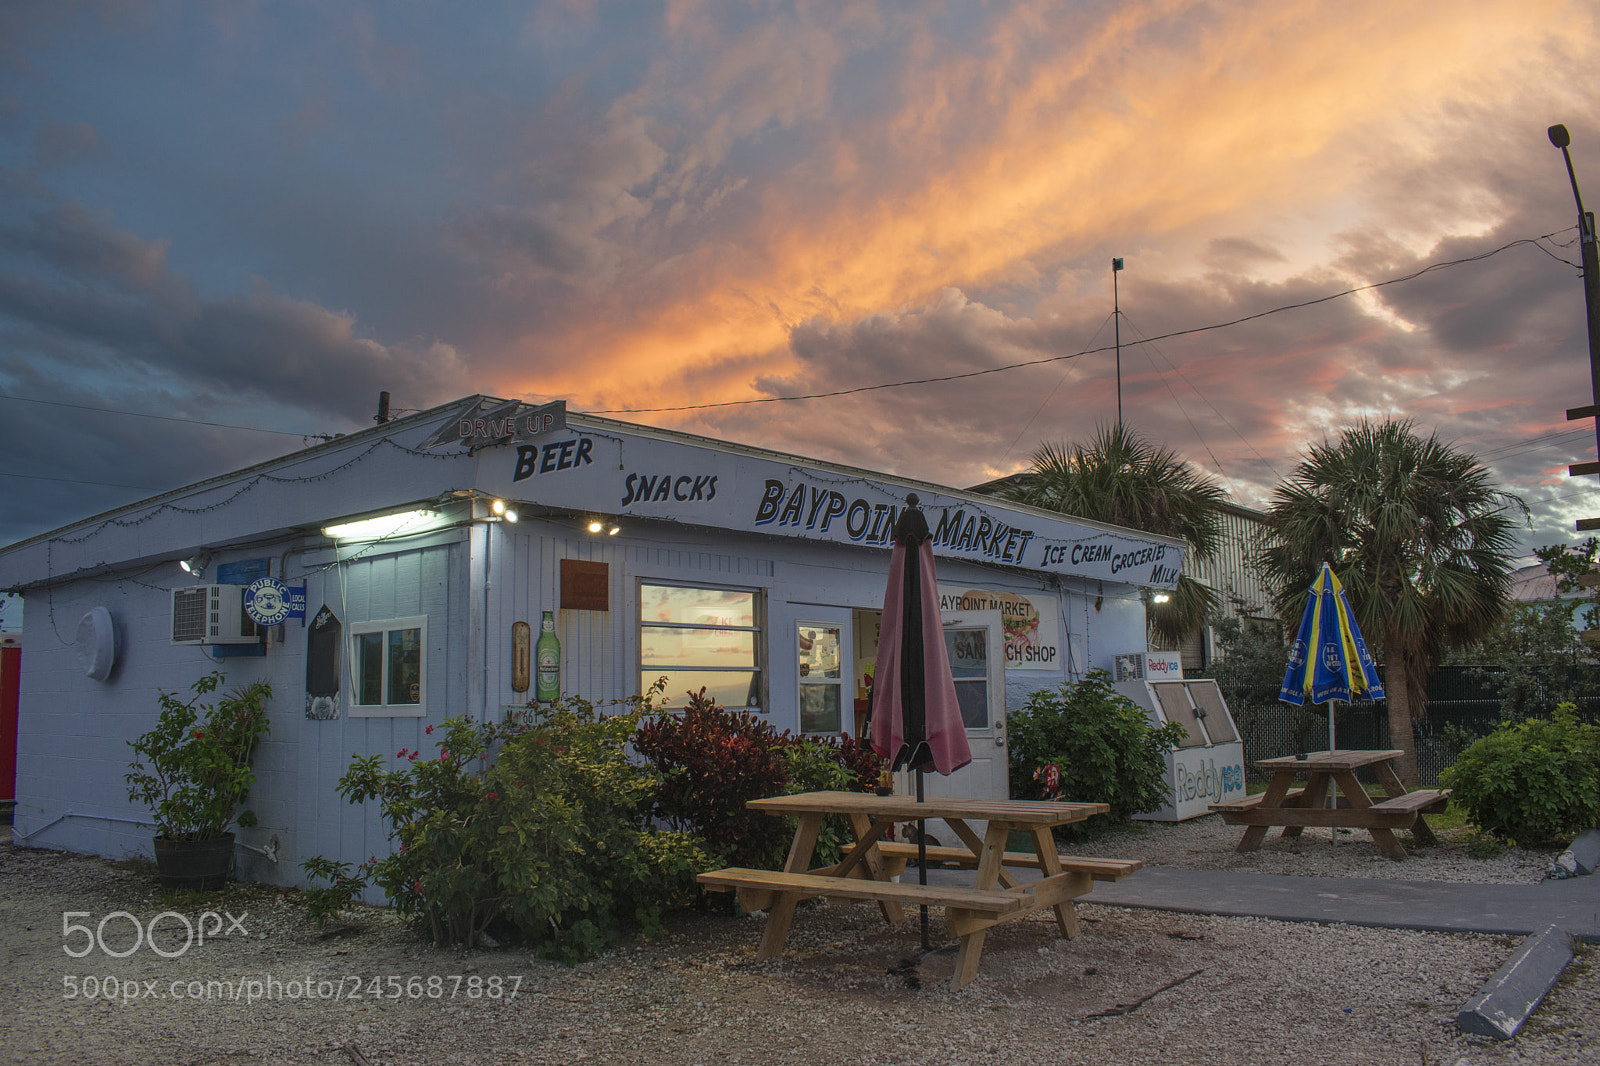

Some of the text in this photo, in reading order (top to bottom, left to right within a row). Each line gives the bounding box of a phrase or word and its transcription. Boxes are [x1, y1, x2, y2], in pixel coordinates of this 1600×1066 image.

[459, 413, 554, 437] DRIVE UP
[513, 438, 593, 482] BEER
[621, 473, 718, 507] SNACKS
[755, 479, 1034, 565] BAYPOIN MARKET
[1041, 543, 1113, 567] ICE CREAM
[1149, 564, 1178, 584] MILK
[250, 579, 287, 594] PUBLIC
[292, 594, 305, 603] LOCAL
[292, 603, 305, 611] CALLS
[989, 600, 1031, 617] MARKET
[246, 600, 290, 624] TELEPHONE
[1025, 645, 1056, 662] SHOP
